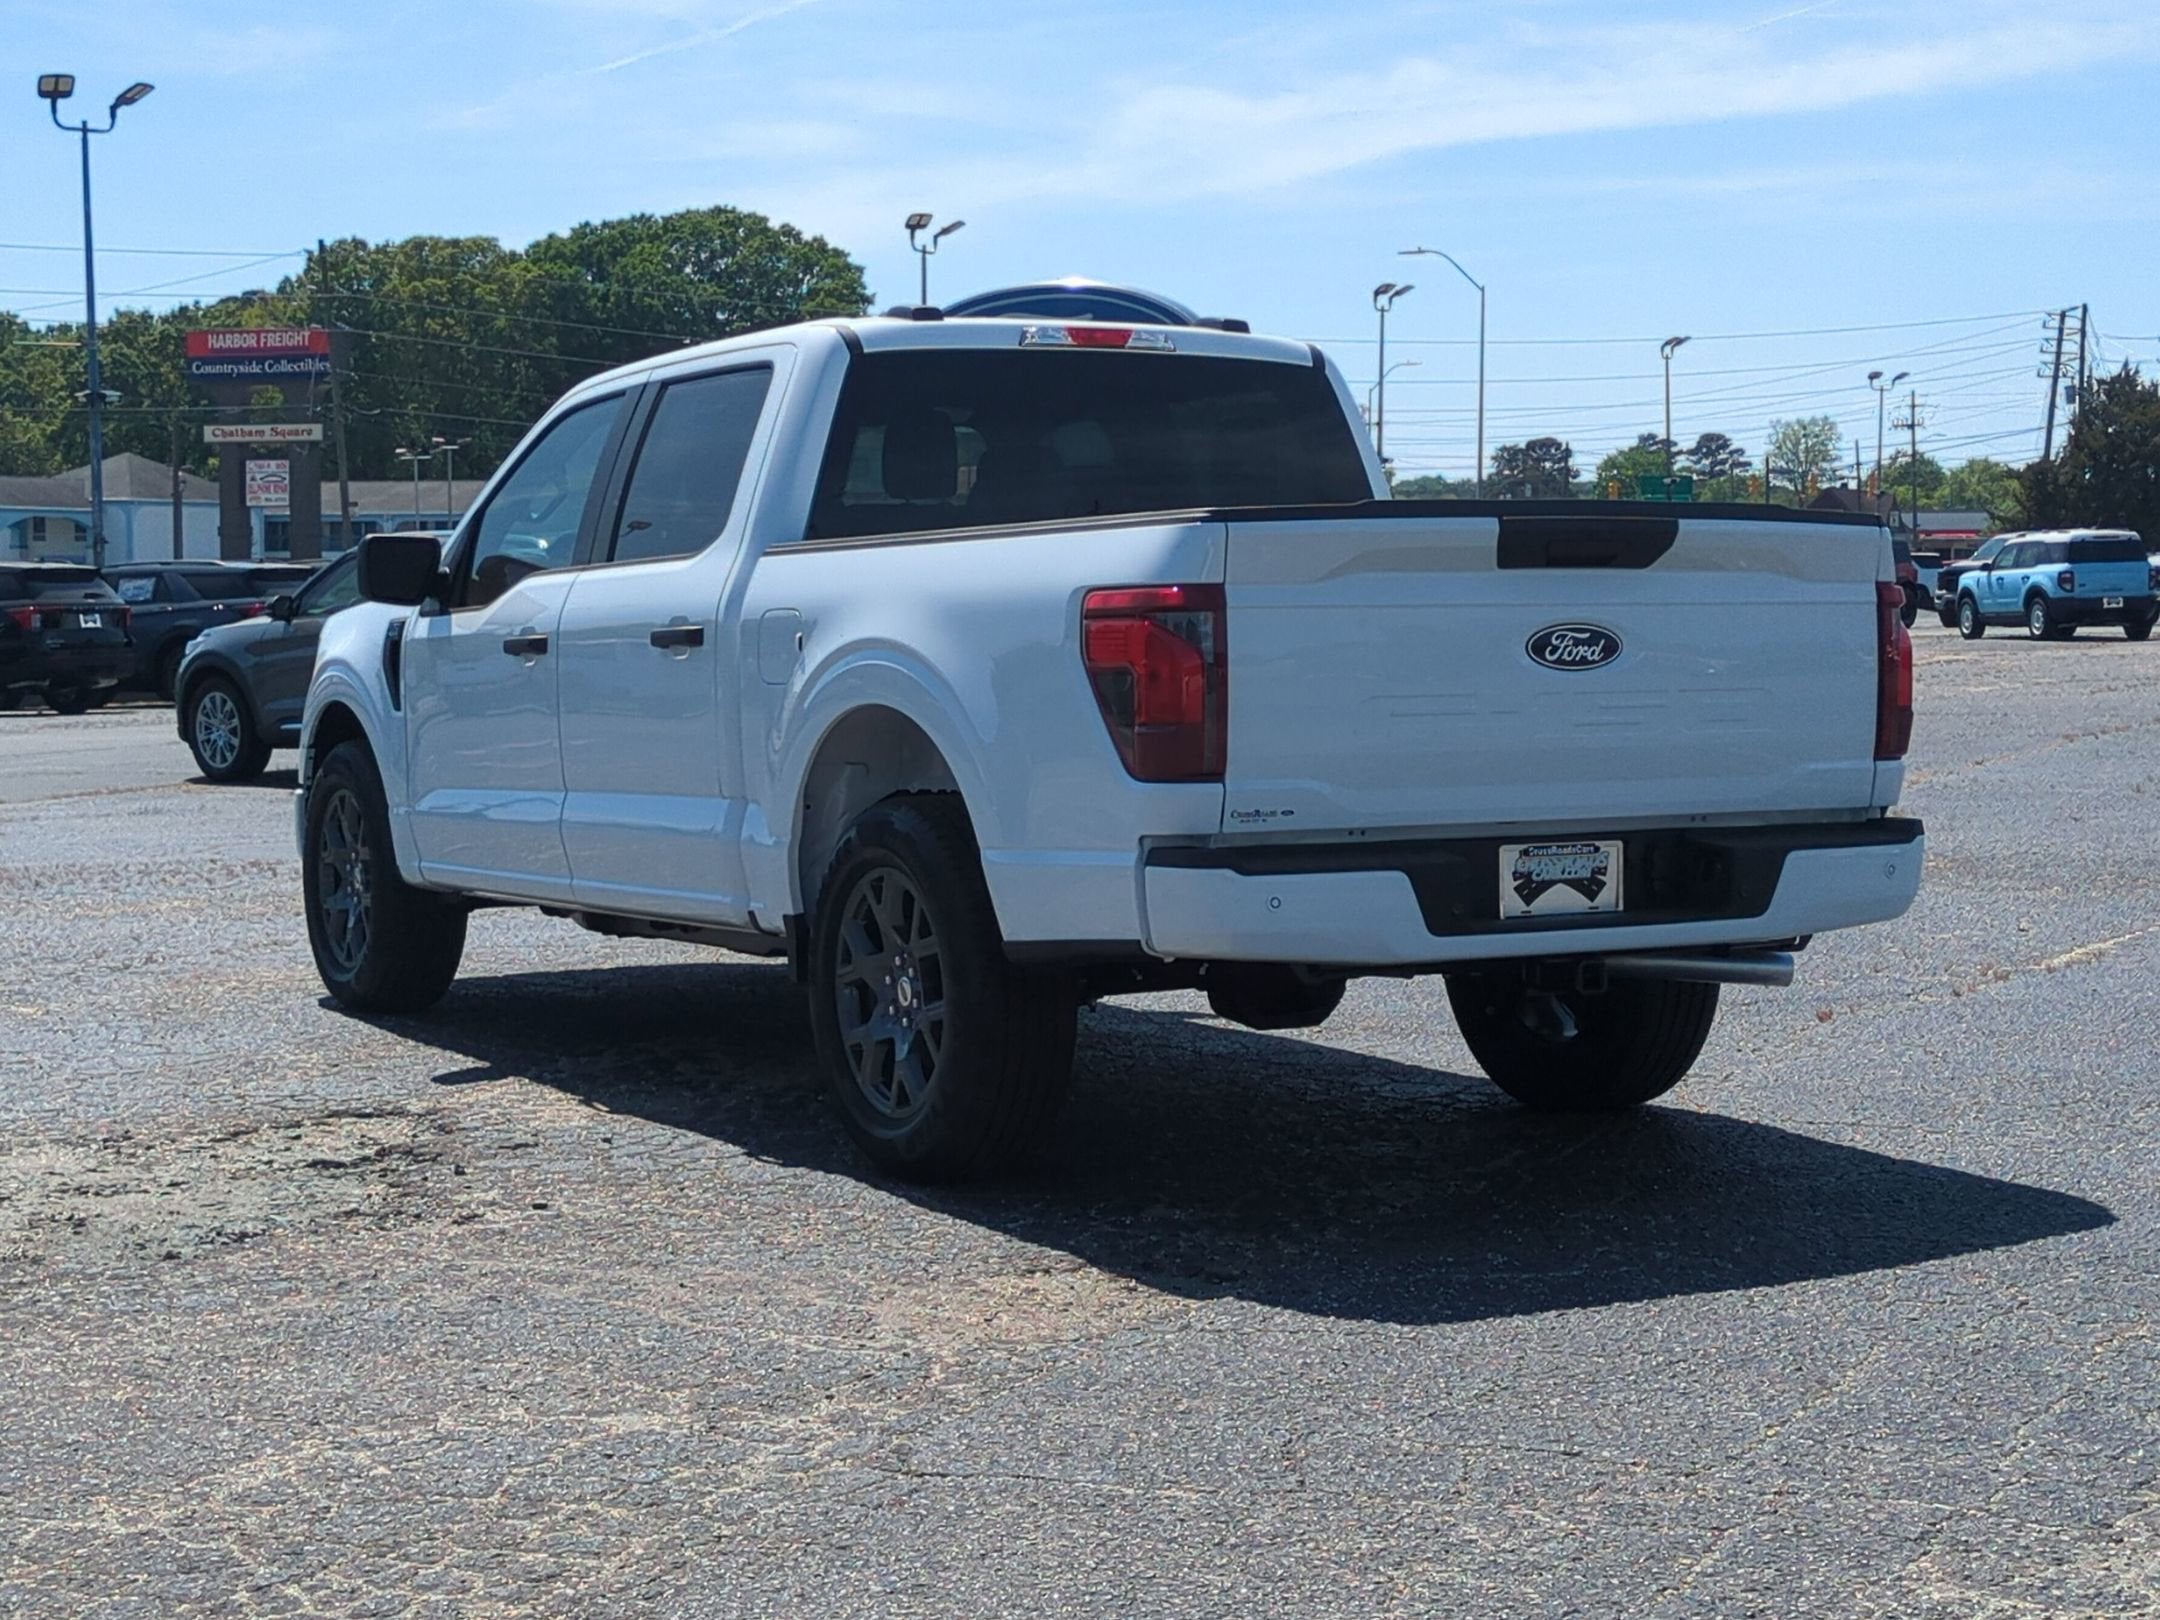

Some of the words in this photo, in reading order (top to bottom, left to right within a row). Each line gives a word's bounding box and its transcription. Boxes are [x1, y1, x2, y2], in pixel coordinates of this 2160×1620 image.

[208, 333, 257, 349] HARBOR
[260, 331, 311, 348] FREIGHT
[192, 360, 262, 377] Countryside
[264, 358, 331, 374] Collectibles
[211, 427, 265, 439] Chatham
[269, 426, 313, 438] Square
[1545, 631, 1605, 661] Ford
